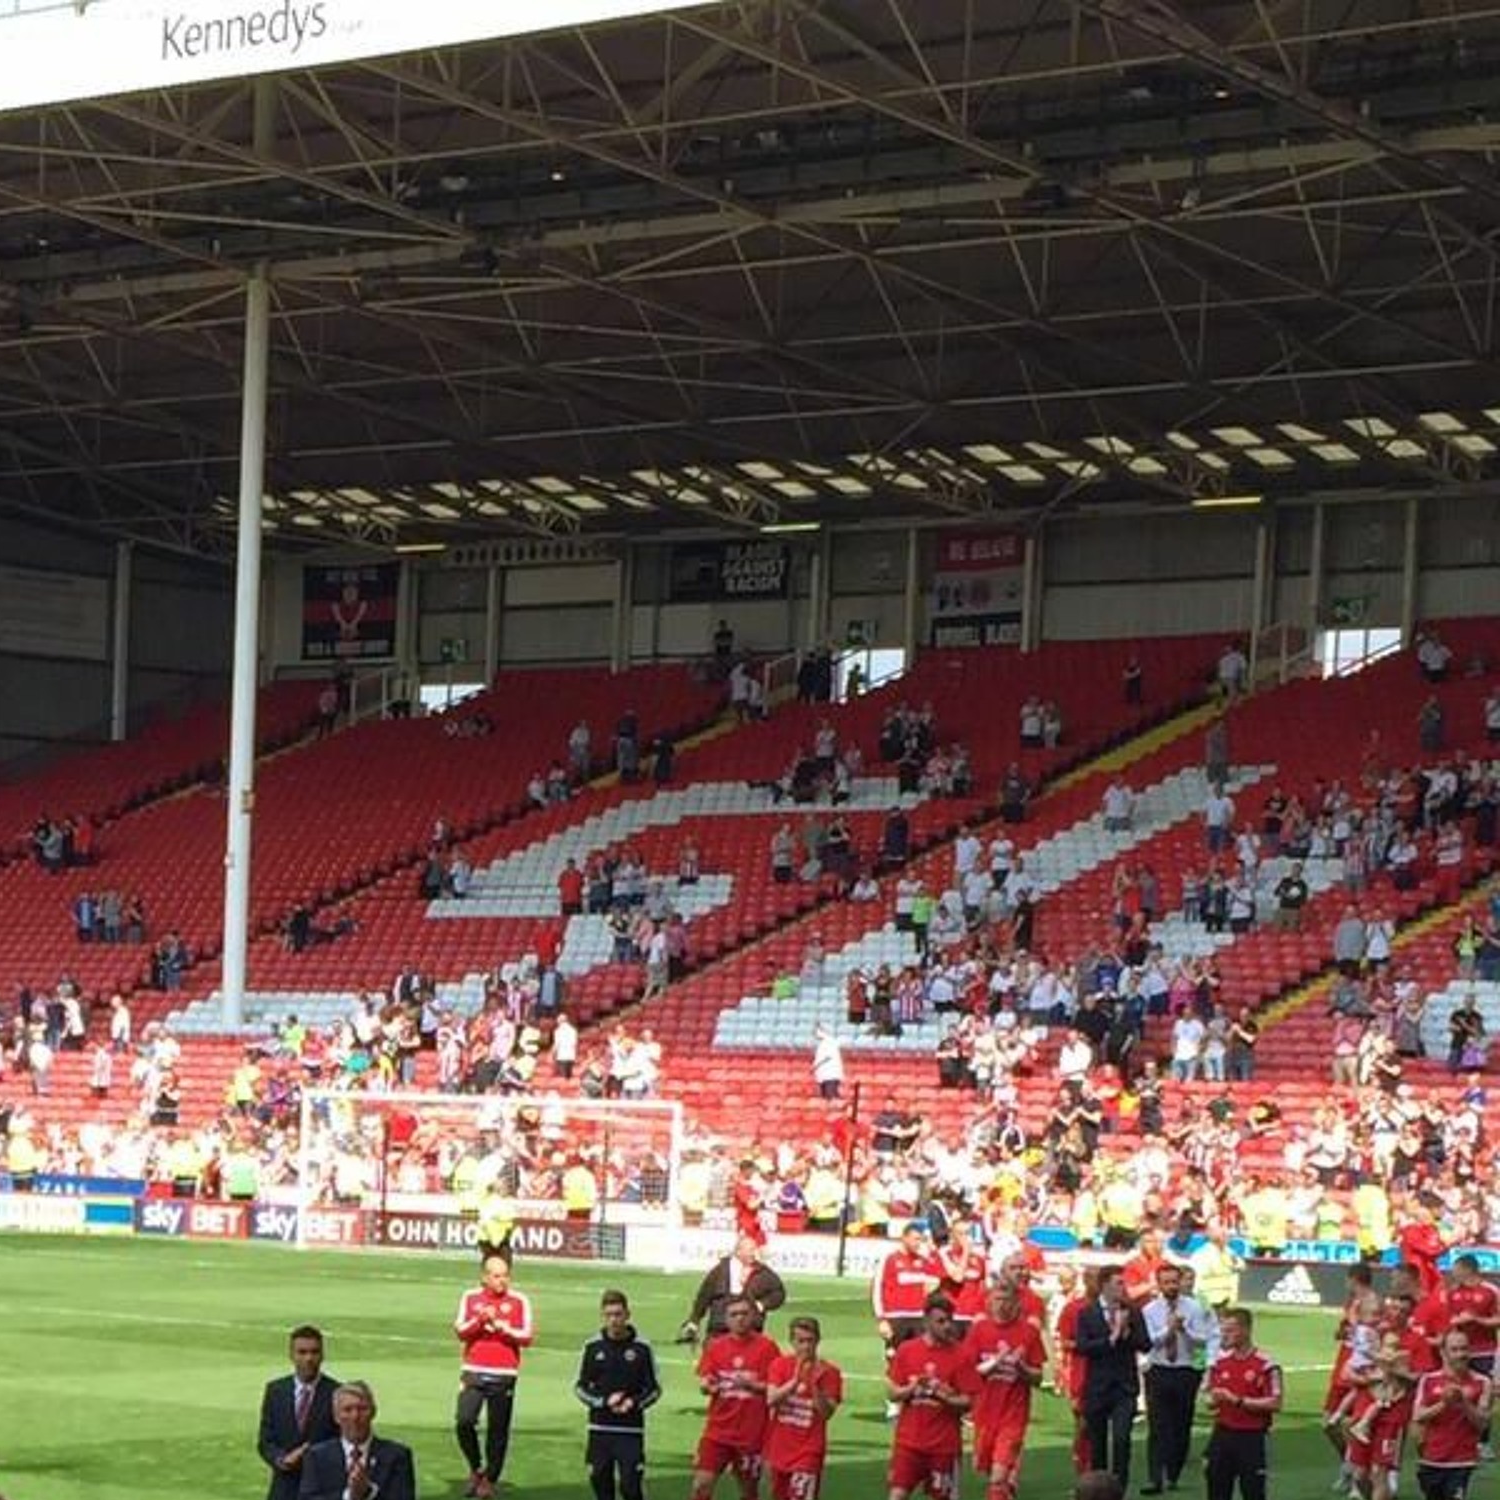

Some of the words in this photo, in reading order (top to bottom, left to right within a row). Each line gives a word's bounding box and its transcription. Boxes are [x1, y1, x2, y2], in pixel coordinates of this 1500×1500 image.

[161, 0, 327, 60] Kennedys
[142, 1199, 182, 1234] sky
[191, 1207, 242, 1233] BET
[256, 1208, 299, 1240] sky
[446, 1223, 564, 1250] HOAND
